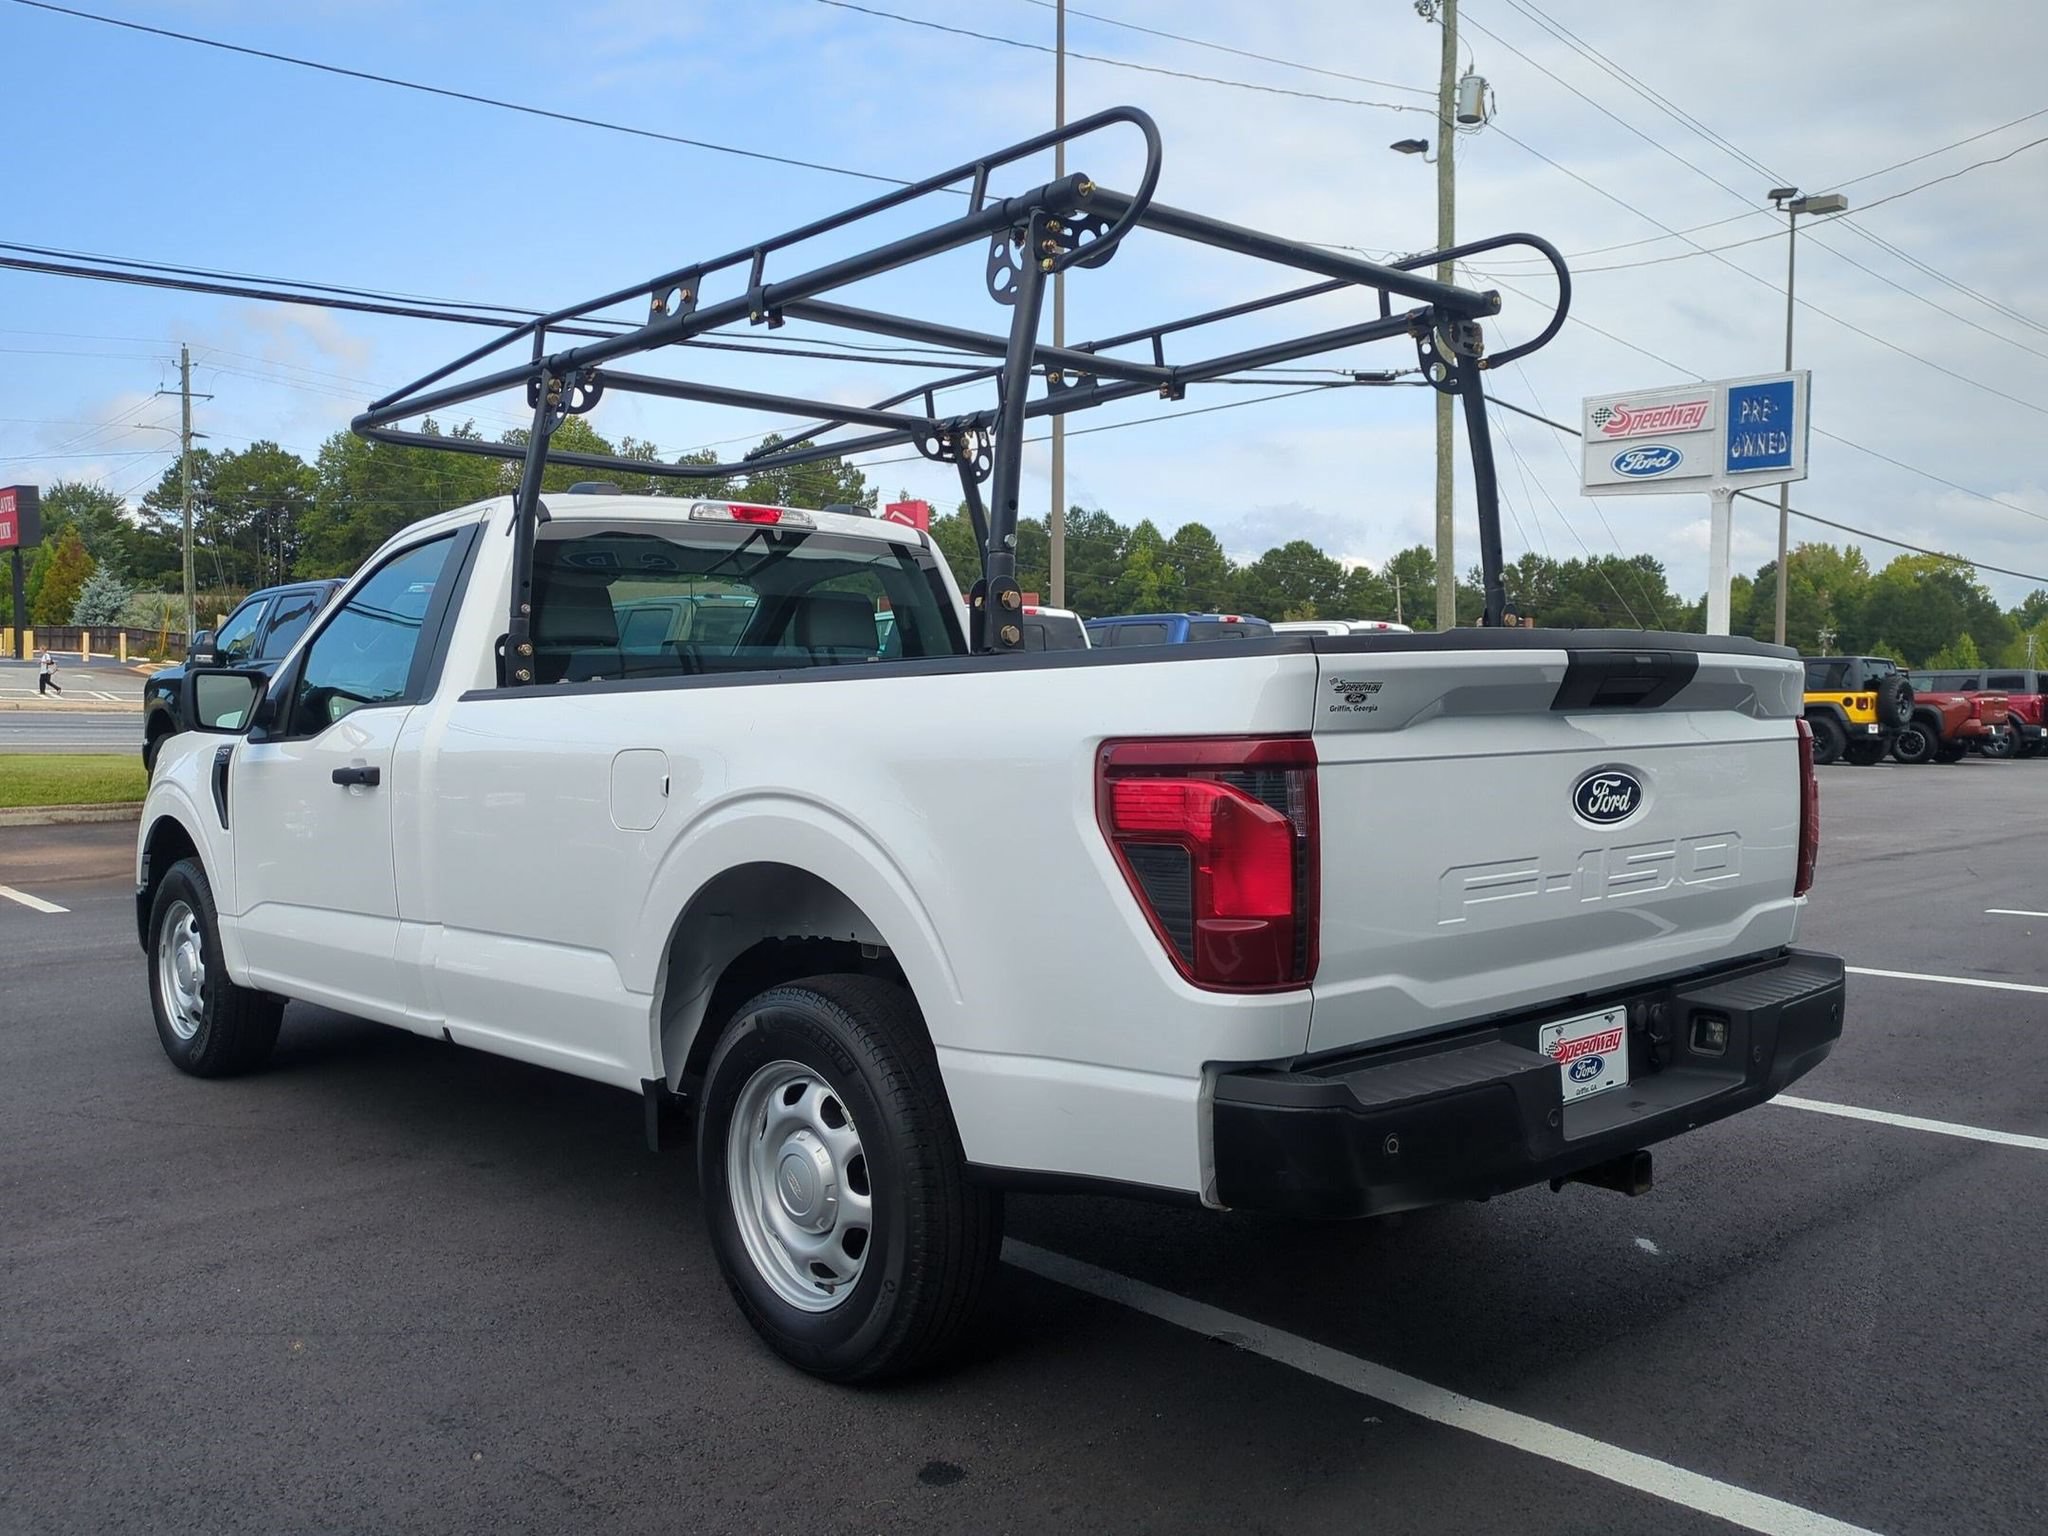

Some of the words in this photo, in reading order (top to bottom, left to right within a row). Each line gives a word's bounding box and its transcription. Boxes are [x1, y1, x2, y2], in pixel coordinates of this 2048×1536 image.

[1602, 402, 1708, 437] Speedway
[1731, 431, 1787, 458] OWNED
[1619, 449, 1672, 472] Ford
[1333, 680, 1384, 693] Speedway
[1353, 704, 1378, 713] Georgia
[1588, 779, 1632, 814] Ford
[1437, 831, 1742, 925] F-150
[1552, 1027, 1623, 1066] Speedway
